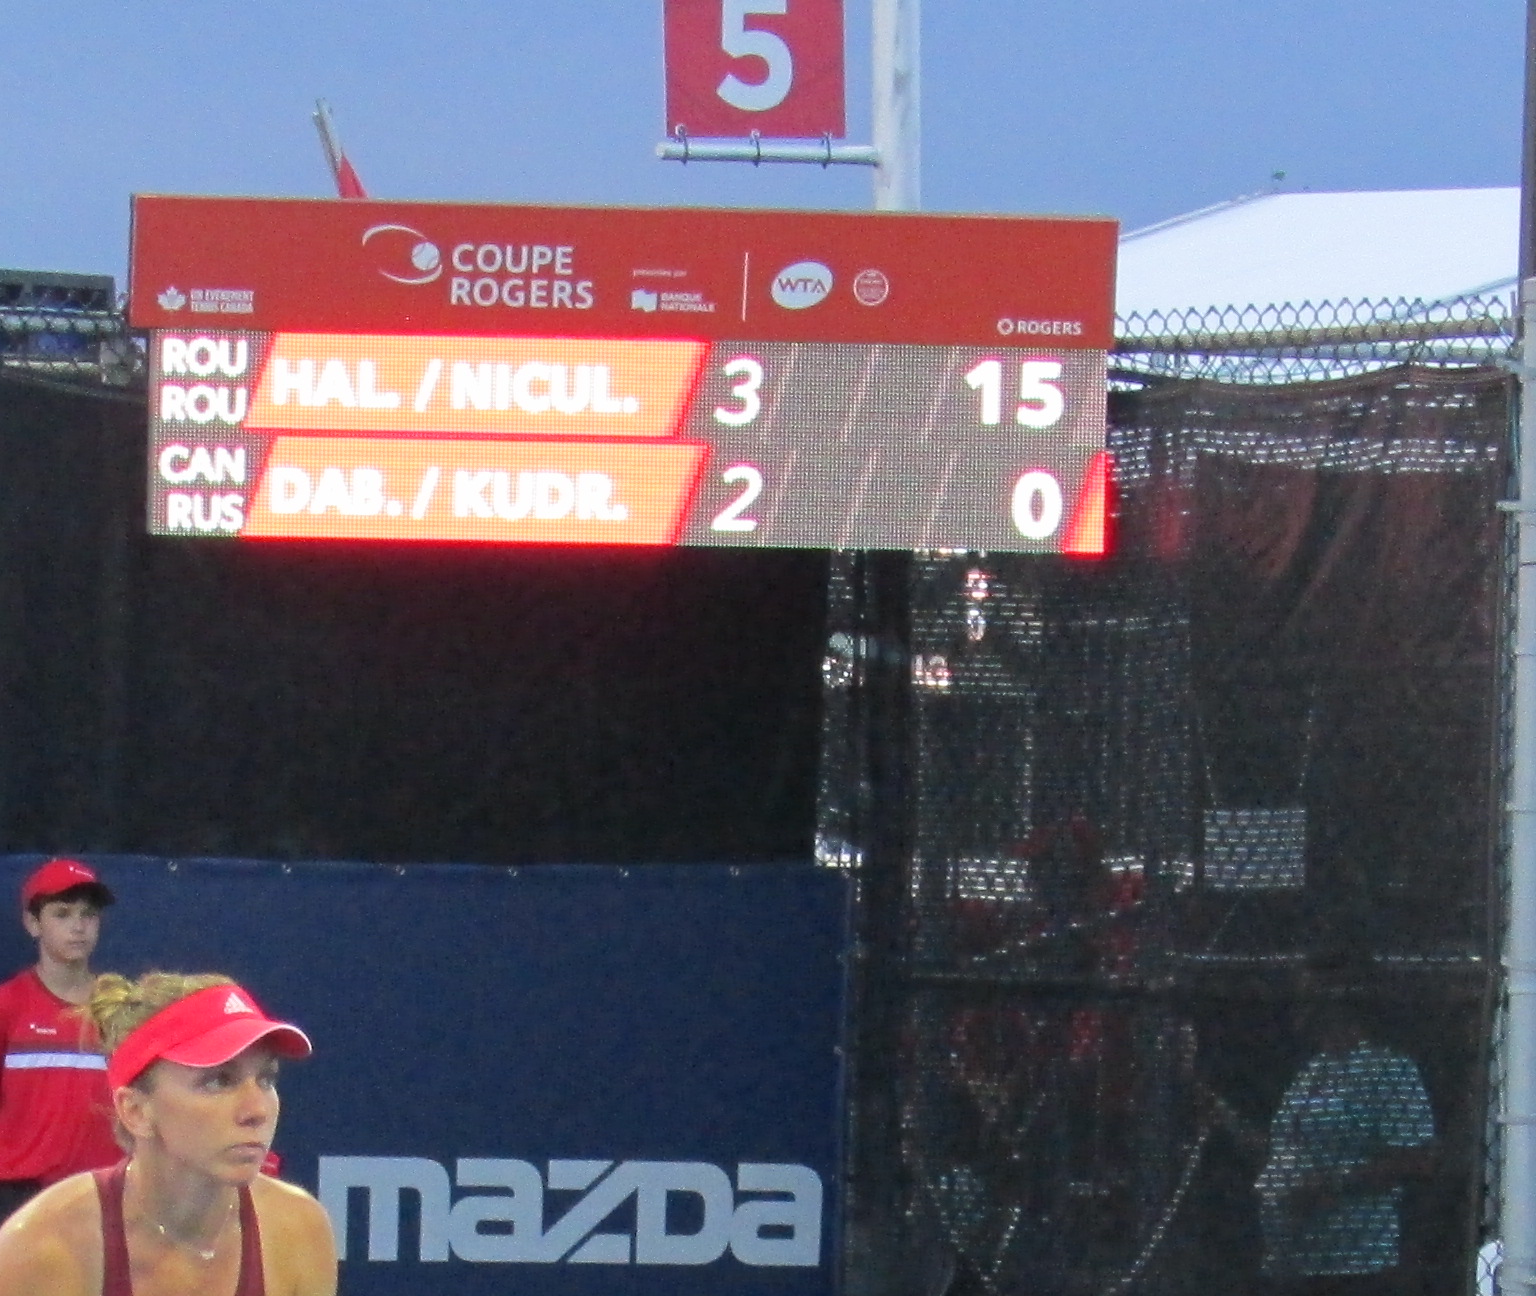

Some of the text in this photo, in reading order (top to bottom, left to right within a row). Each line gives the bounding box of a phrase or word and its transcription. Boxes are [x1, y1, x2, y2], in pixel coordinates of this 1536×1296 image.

[715, 0, 794, 112] 5
[451, 243, 574, 275] COUPE
[450, 276, 594, 309] ROGERS
[660, 292, 703, 302] BANQUE
[777, 277, 828, 294] WTA
[660, 302, 716, 313] NATIONALE
[1016, 320, 1082, 336] ROGERS
[162, 337, 248, 377] ROU
[161, 384, 248, 424] ROU
[270, 356, 402, 412] HAL.
[448, 359, 640, 416] NICUL.
[713, 358, 763, 427] 3
[966, 360, 1064, 429] 15
[158, 444, 246, 484] CAN
[166, 492, 246, 531] RUS
[267, 463, 404, 518] DAB.
[450, 467, 632, 522] KUDR.
[710, 465, 763, 532] 2
[1011, 470, 1063, 540] 0
